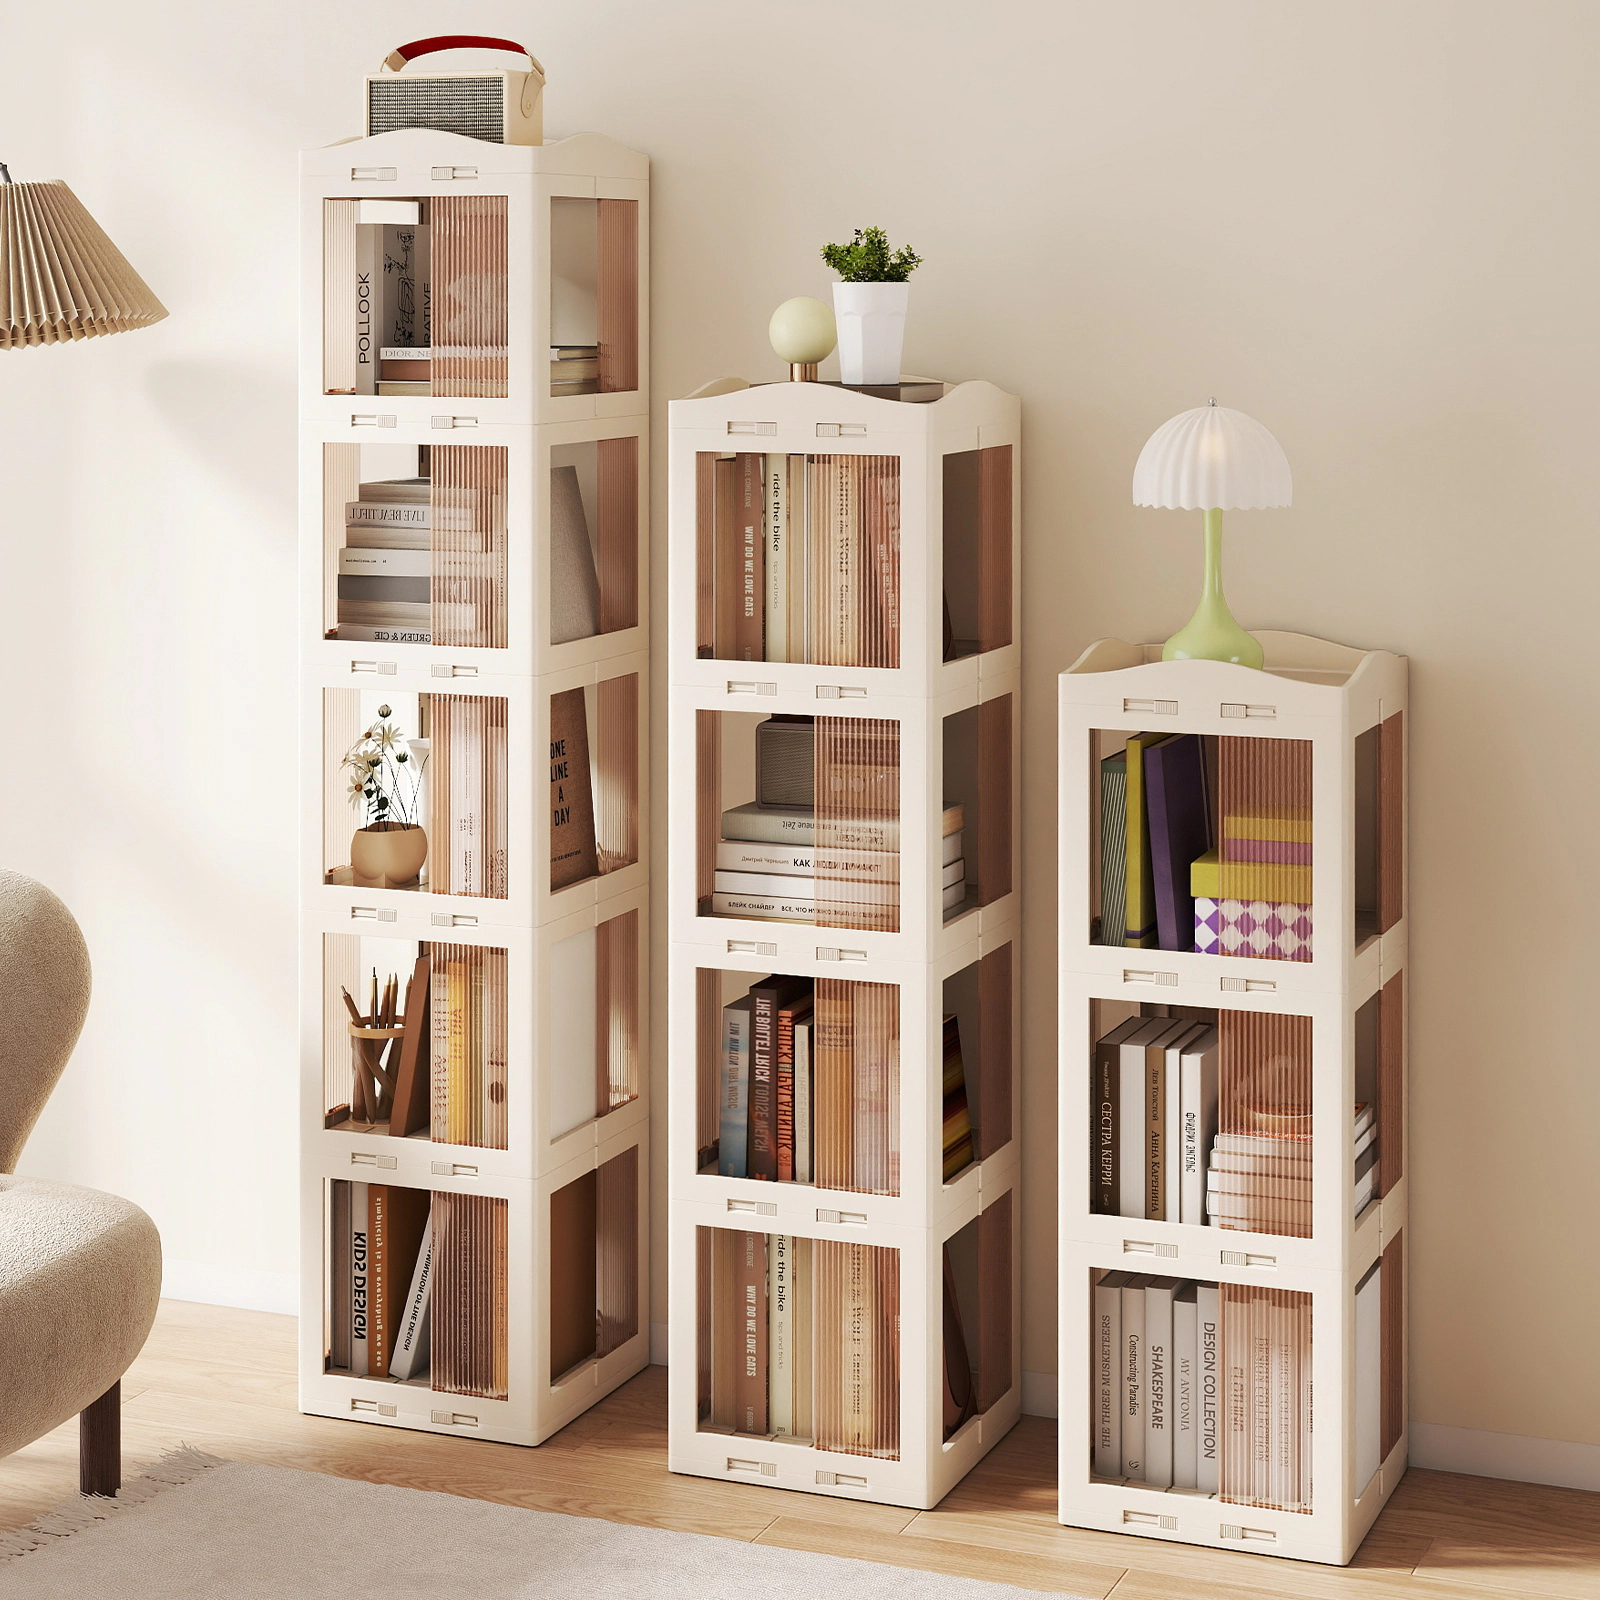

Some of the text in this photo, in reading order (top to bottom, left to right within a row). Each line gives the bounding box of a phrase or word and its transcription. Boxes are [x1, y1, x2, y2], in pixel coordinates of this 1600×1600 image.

[358, 272, 370, 364] POLLOCK
[773, 473, 781, 498] ride
[773, 501, 781, 522] the
[744, 525, 754, 545] WHY
[773, 525, 781, 552] bike
[744, 546, 754, 558] DO
[744, 559, 754, 573] WE
[744, 574, 754, 595] LOVE
[744, 597, 754, 617] CATS
[550, 739, 566, 760] ONE
[550, 761, 569, 783] LINE
[558, 785, 565, 803] A
[554, 806, 571, 827] DAY
[782, 820, 796, 830] Zeit
[793, 858, 811, 868] КАК
[728, 901, 747, 909] БЛЕЙК
[748, 902, 775, 911] СНАЙДЕР
[1101, 1102, 1113, 1146] СЕСТРА
[1185, 1112, 1197, 1173] ФРИДРИХ ЭНГЕЛЬС
[1101, 1148, 1113, 1186] КЕРРИ
[777, 1234, 786, 1258] ride
[777, 1261, 786, 1282] the
[746, 1285, 756, 1305] WHY
[777, 1285, 786, 1313] bike
[746, 1306, 756, 1318] DO
[746, 1319, 756, 1333] WE
[746, 1334, 757, 1354] LOVE
[746, 1356, 757, 1377] CATS
[1126, 1334, 1140, 1416] Constructing Paradies
[1101, 1315, 1111, 1449] THE THREE MUSKETEERS
[1151, 1345, 1164, 1430] SHAKESPEARE
[1203, 1321, 1216, 1460] DESIGN COLLECTION
[1180, 1357, 1190, 1431] MY ANTONIA
